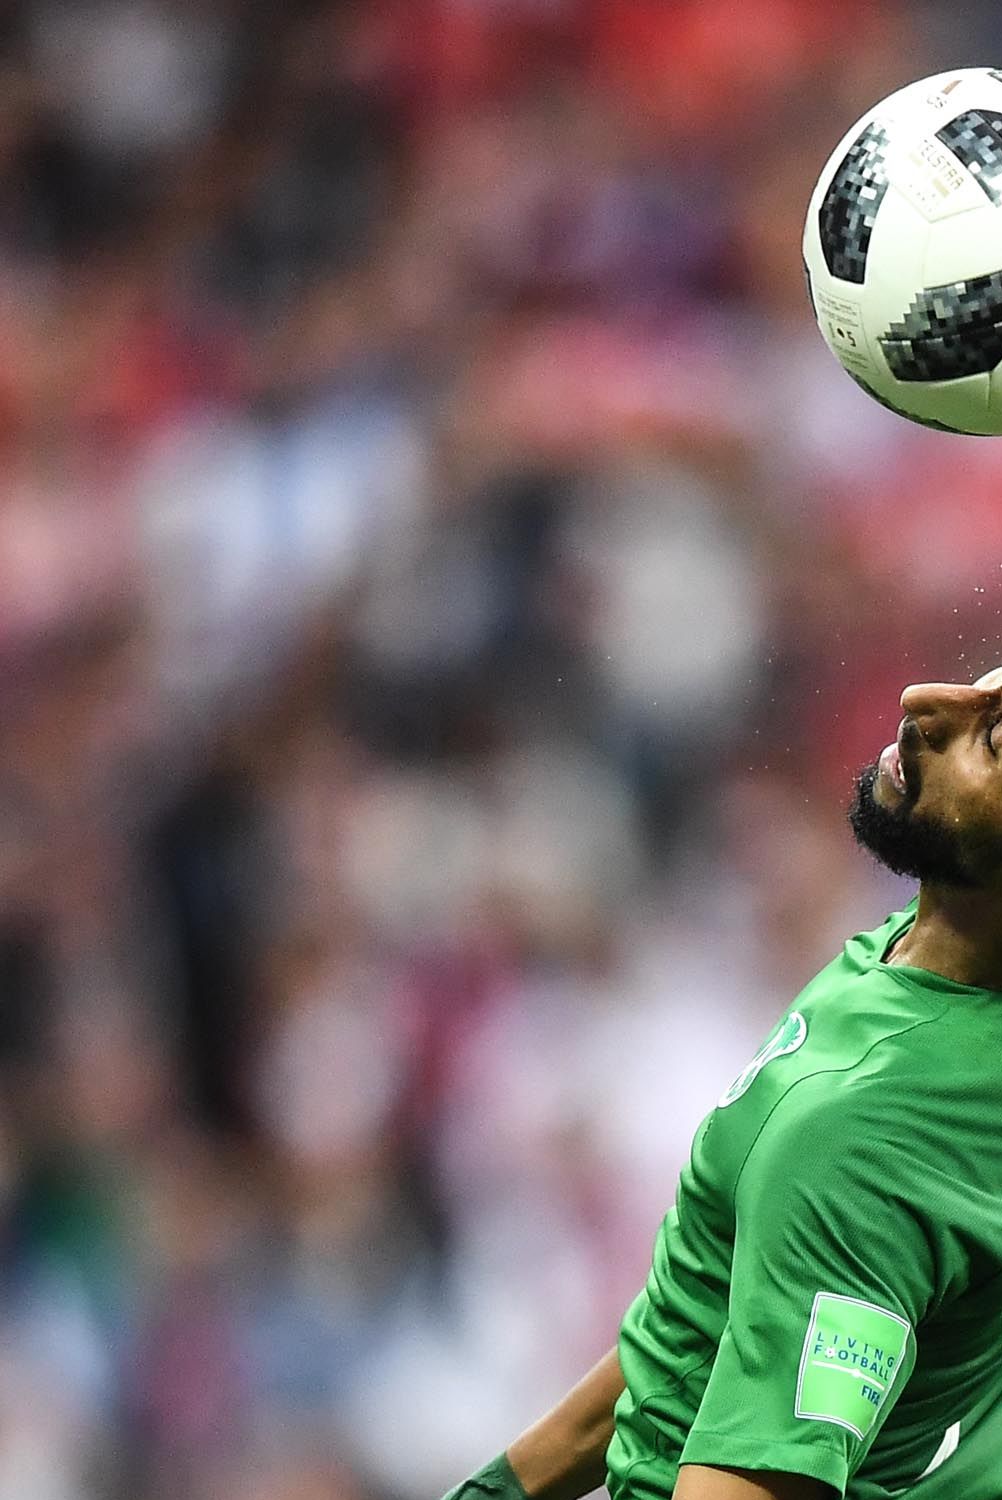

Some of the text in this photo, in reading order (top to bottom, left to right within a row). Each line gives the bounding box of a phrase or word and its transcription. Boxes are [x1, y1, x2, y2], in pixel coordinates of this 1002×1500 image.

[918, 138, 964, 191] TELSTAR
[814, 1344, 891, 1381] FOOTBALL
[816, 1331, 895, 1368] LIVING
